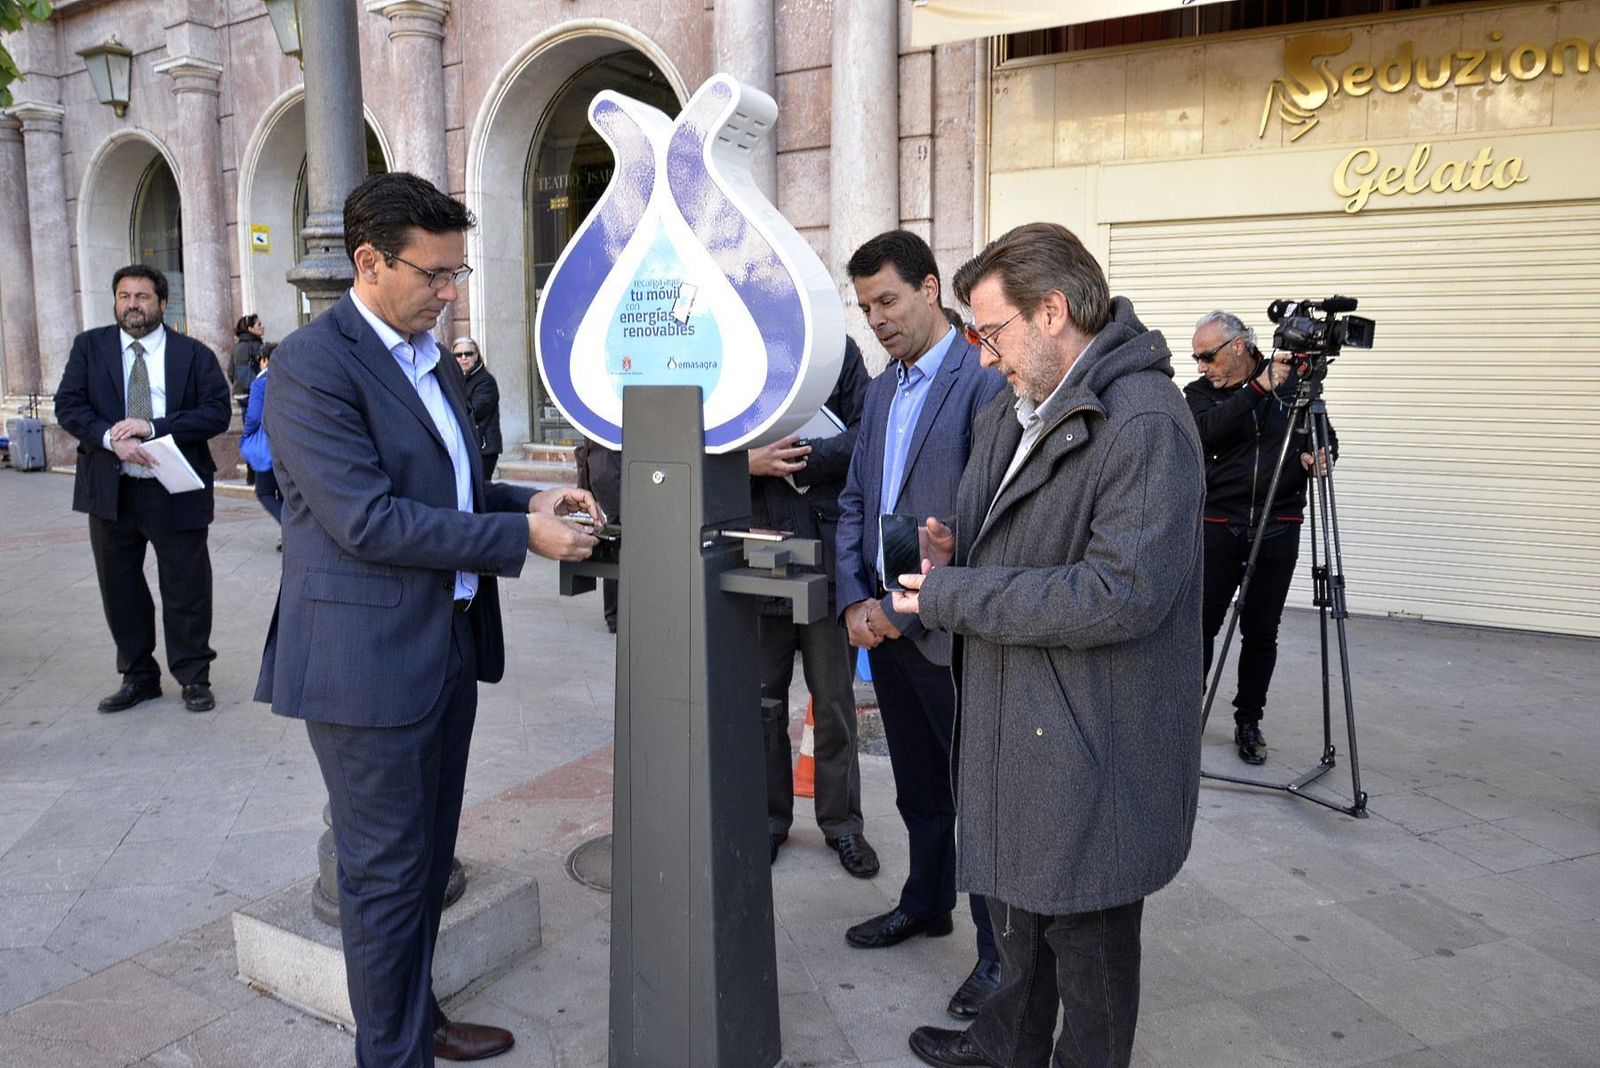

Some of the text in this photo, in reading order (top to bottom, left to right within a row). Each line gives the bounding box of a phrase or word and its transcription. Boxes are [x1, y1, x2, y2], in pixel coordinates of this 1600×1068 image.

[1258, 32, 1600, 141] Seduzion
[539, 173, 580, 191] TEATRO
[1332, 143, 1529, 214] Gelato
[631, 286, 681, 301] tu móvil
[625, 302, 640, 311] con
[620, 307, 675, 326] energías
[623, 322, 695, 338] renovables
[678, 361, 718, 370] emasagra
